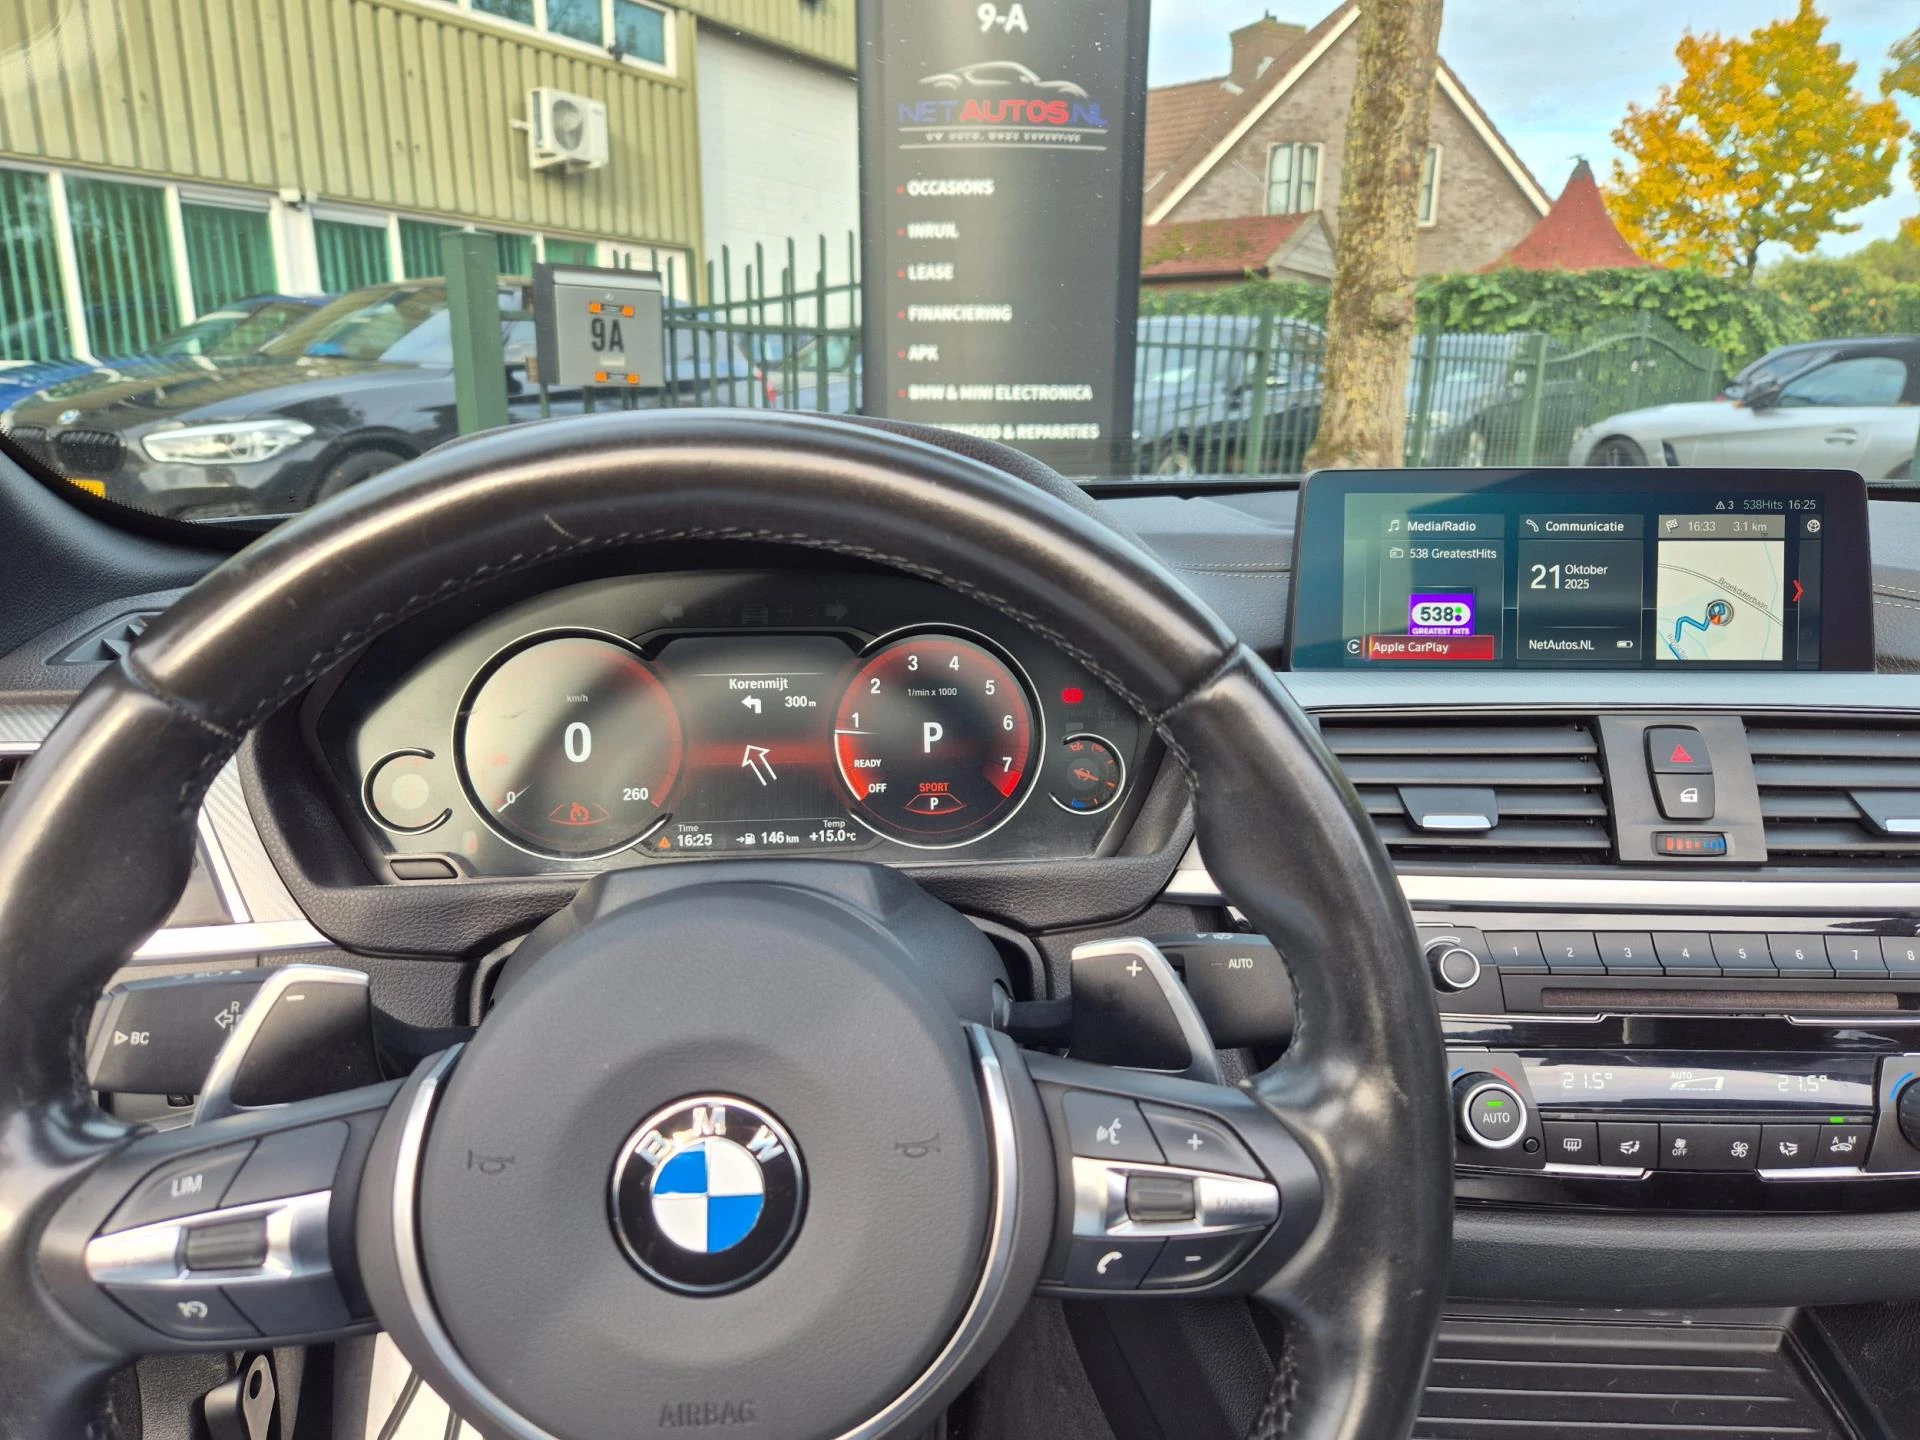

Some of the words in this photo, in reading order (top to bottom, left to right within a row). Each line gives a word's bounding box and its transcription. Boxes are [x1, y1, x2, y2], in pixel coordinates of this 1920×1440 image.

[977, 3, 1029, 33] 9-A
[907, 179, 995, 196] OCCASIONS
[907, 221, 959, 239] INRUIL
[907, 264, 954, 280] LEASE
[907, 304, 1013, 322] FINANCIERING
[591, 318, 624, 353] 9A
[907, 344, 939, 361] APK
[907, 384, 946, 401] BMW
[947, 384, 958, 401] &
[960, 384, 993, 401] MINI
[995, 384, 1093, 401] ELECTRONICA
[1003, 423, 1015, 440] &
[1016, 423, 1100, 440] REPARATIES
[1728, 500, 1734, 510] 3
[1743, 500, 1783, 510] 538Hits
[1788, 500, 1816, 510] 16:25
[1407, 520, 1476, 532] Media/Radio
[1545, 520, 1624, 532] Communicatie
[1688, 521, 1716, 532] 16:33
[1733, 521, 1748, 532] 3.1
[1751, 522, 1767, 532] km
[1410, 548, 1428, 559] 538
[1431, 547, 1497, 559] GreatestHits
[1565, 564, 1608, 575] Oktober
[1531, 564, 1560, 589] 21
[1565, 578, 1589, 589] 2025
[1412, 627, 1451, 635] GREATEST
[1453, 627, 1470, 635] HITS
[1373, 642, 1405, 652] Apple
[1408, 642, 1449, 653] CarPlay
[1529, 639, 1594, 650] NetAutos.NL
[908, 656, 918, 671] 3
[949, 656, 959, 670] 4
[729, 678, 788, 691] Korenmijt
[870, 678, 881, 694] 2
[985, 680, 995, 695] 5
[565, 693, 589, 703] km/h
[907, 688, 930, 697] 1/min
[938, 687, 957, 696] 1000
[785, 696, 807, 707] 300
[852, 712, 860, 728] 1
[1003, 715, 1014, 730] 6
[564, 722, 592, 763] 0
[923, 722, 943, 753] P
[854, 759, 881, 768] READY
[1002, 757, 1012, 772] 7
[868, 784, 887, 793] OFF
[919, 783, 949, 792] SPORT
[623, 787, 648, 801] 260
[930, 798, 939, 810] P
[678, 824, 699, 832] Time
[823, 820, 846, 829] Temp
[677, 834, 712, 846] 16:25
[761, 832, 784, 844] 146
[786, 834, 799, 843] km
[1513, 946, 1518, 956] 1
[1566, 947, 1574, 957] 2
[1624, 948, 1632, 958] 3
[1682, 948, 1690, 958] 4
[1739, 948, 1747, 959] 5
[1796, 950, 1803, 960] 6
[1852, 950, 1858, 960] 7
[1907, 950, 1915, 960] 8
[1228, 958, 1253, 969] AUTO
[130, 1031, 149, 1045] BC
[1670, 1072, 1692, 1080] AUTO
[1483, 1112, 1510, 1123] AUTO
[635, 1106, 784, 1166] BMW
[1672, 1148, 1687, 1156] OFF
[171, 1174, 203, 1197] LIM
[659, 1400, 756, 1427] AIRBAG
